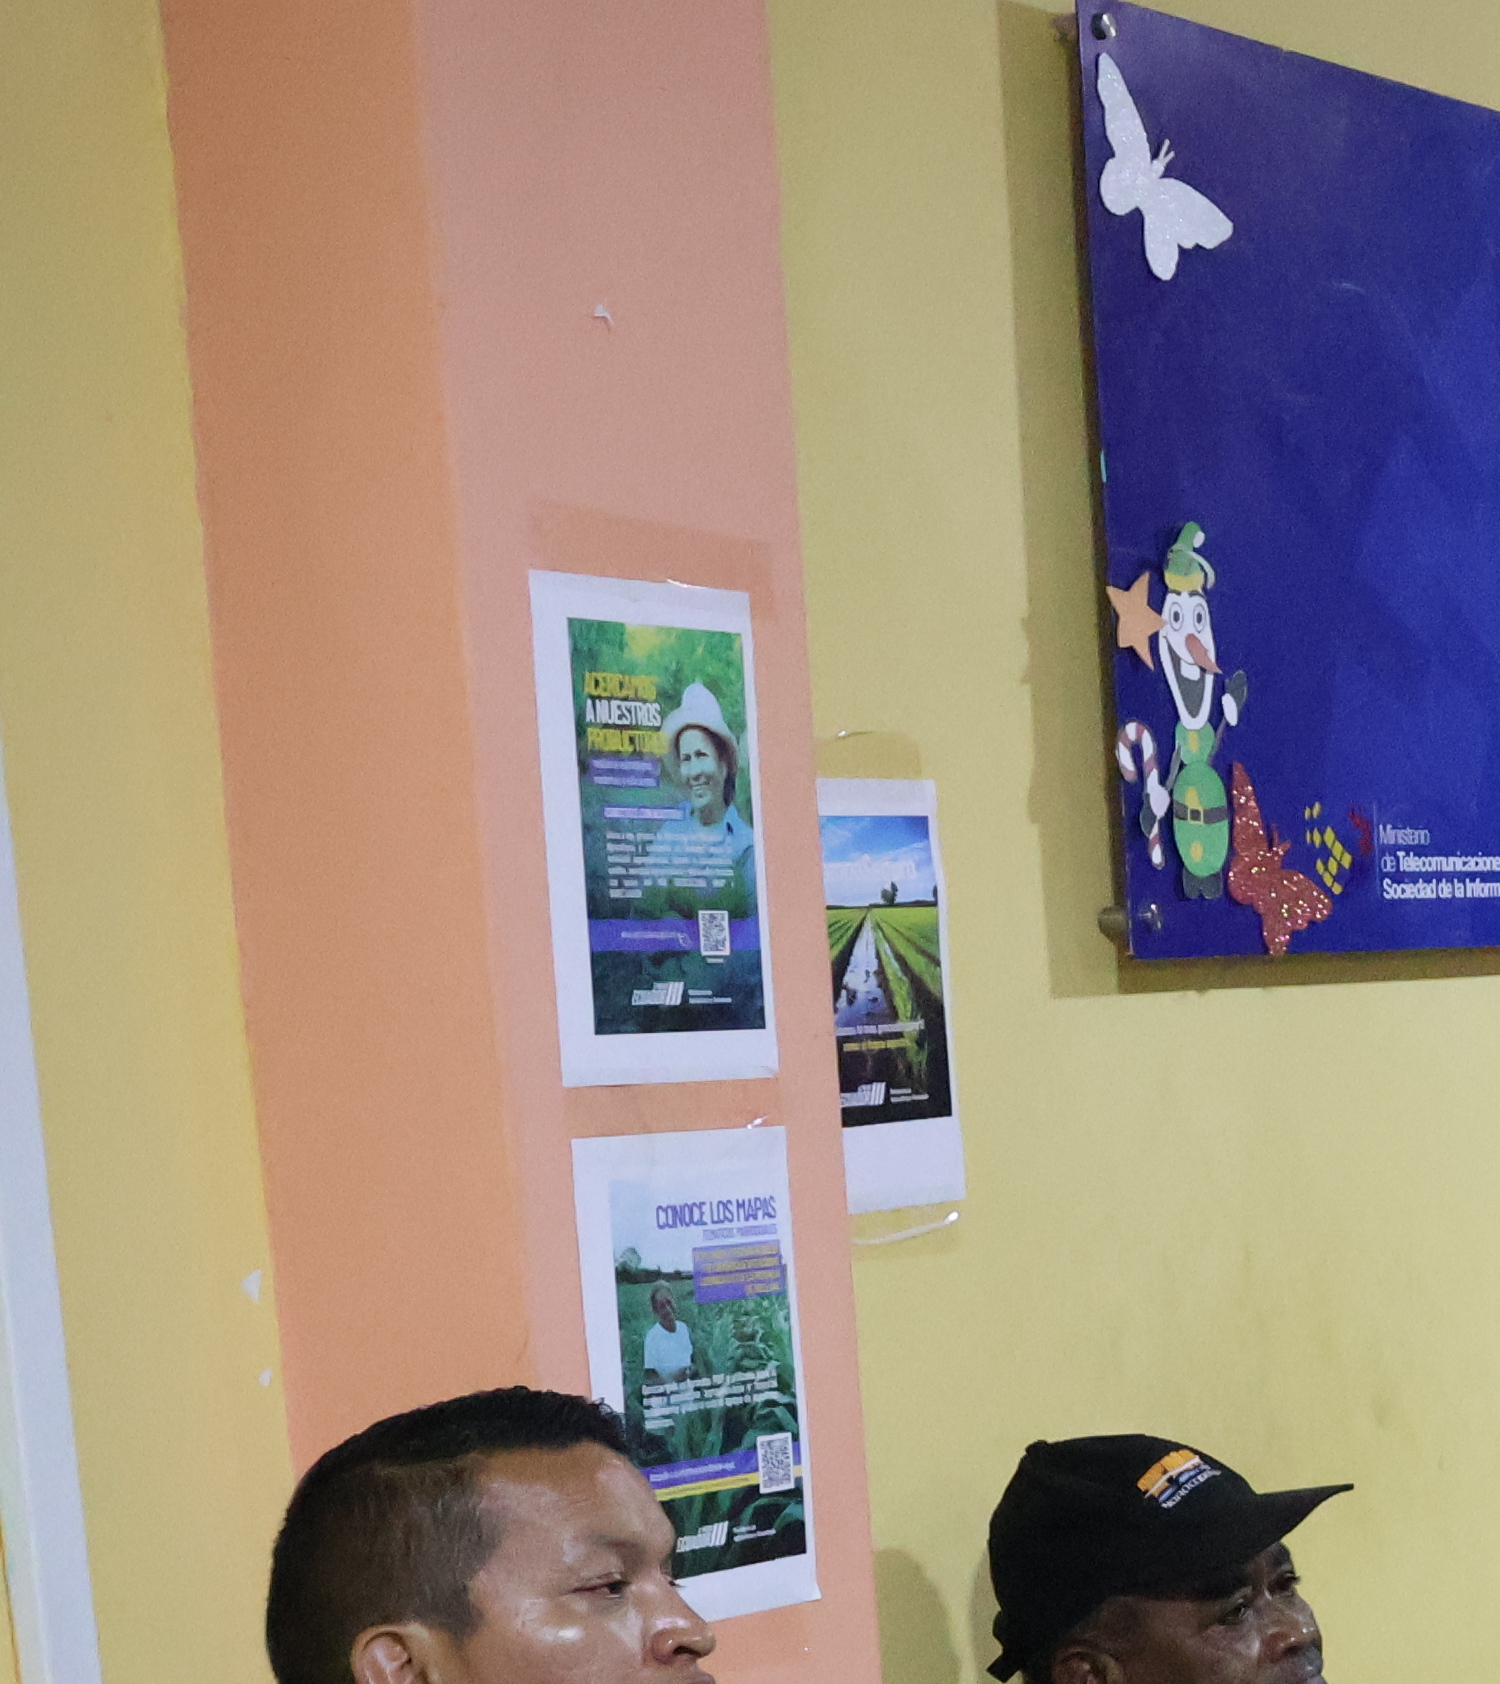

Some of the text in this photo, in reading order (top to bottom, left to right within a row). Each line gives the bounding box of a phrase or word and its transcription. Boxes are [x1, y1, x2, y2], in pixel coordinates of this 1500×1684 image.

[595, 700, 661, 727] NUESTROS
[1379, 824, 1430, 845] Ministerio
[1381, 853, 1396, 872] de
[1383, 878, 1437, 899] Sociedad
[1438, 878, 1452, 898] de
[1453, 878, 1465, 898] la
[656, 1196, 777, 1229] CONOCE LOS MAPAS
